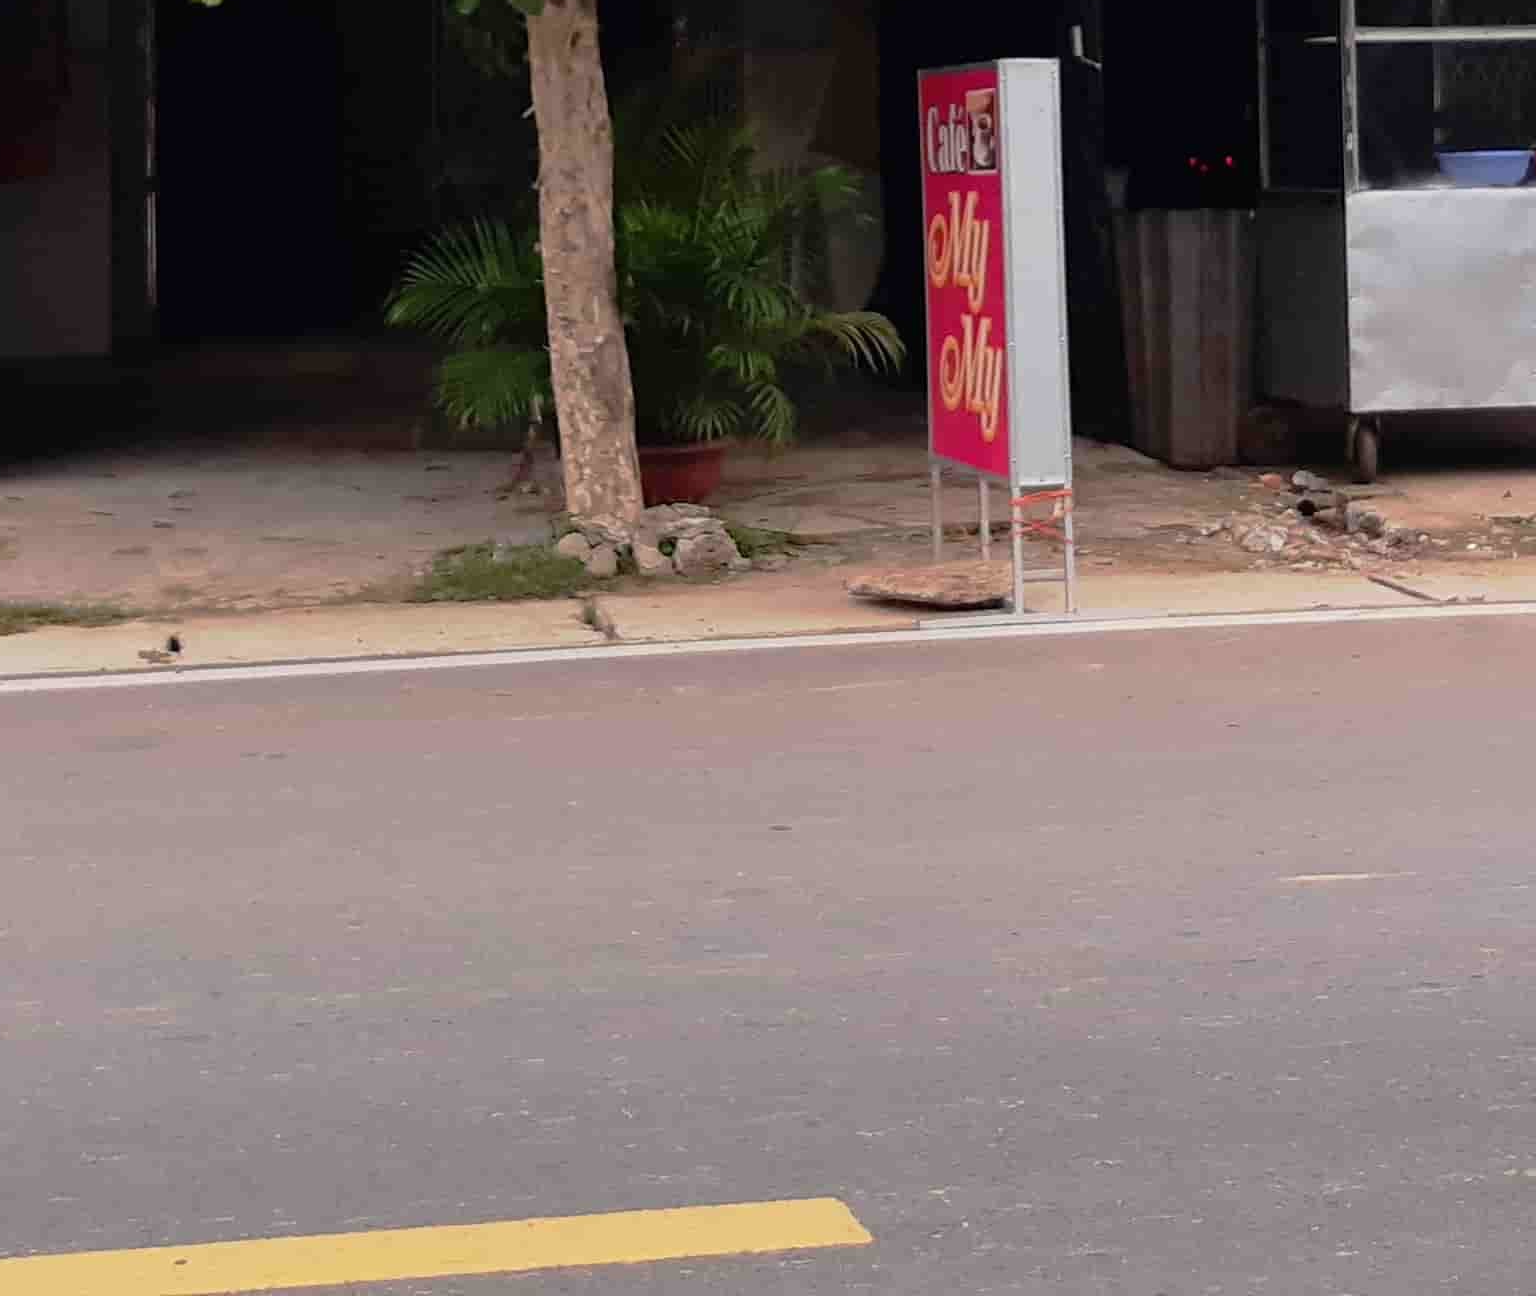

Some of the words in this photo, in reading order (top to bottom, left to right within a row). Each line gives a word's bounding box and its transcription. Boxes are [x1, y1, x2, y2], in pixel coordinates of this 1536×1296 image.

[927, 104, 968, 173] Café
[927, 191, 990, 313] My
[939, 314, 1003, 442] My
